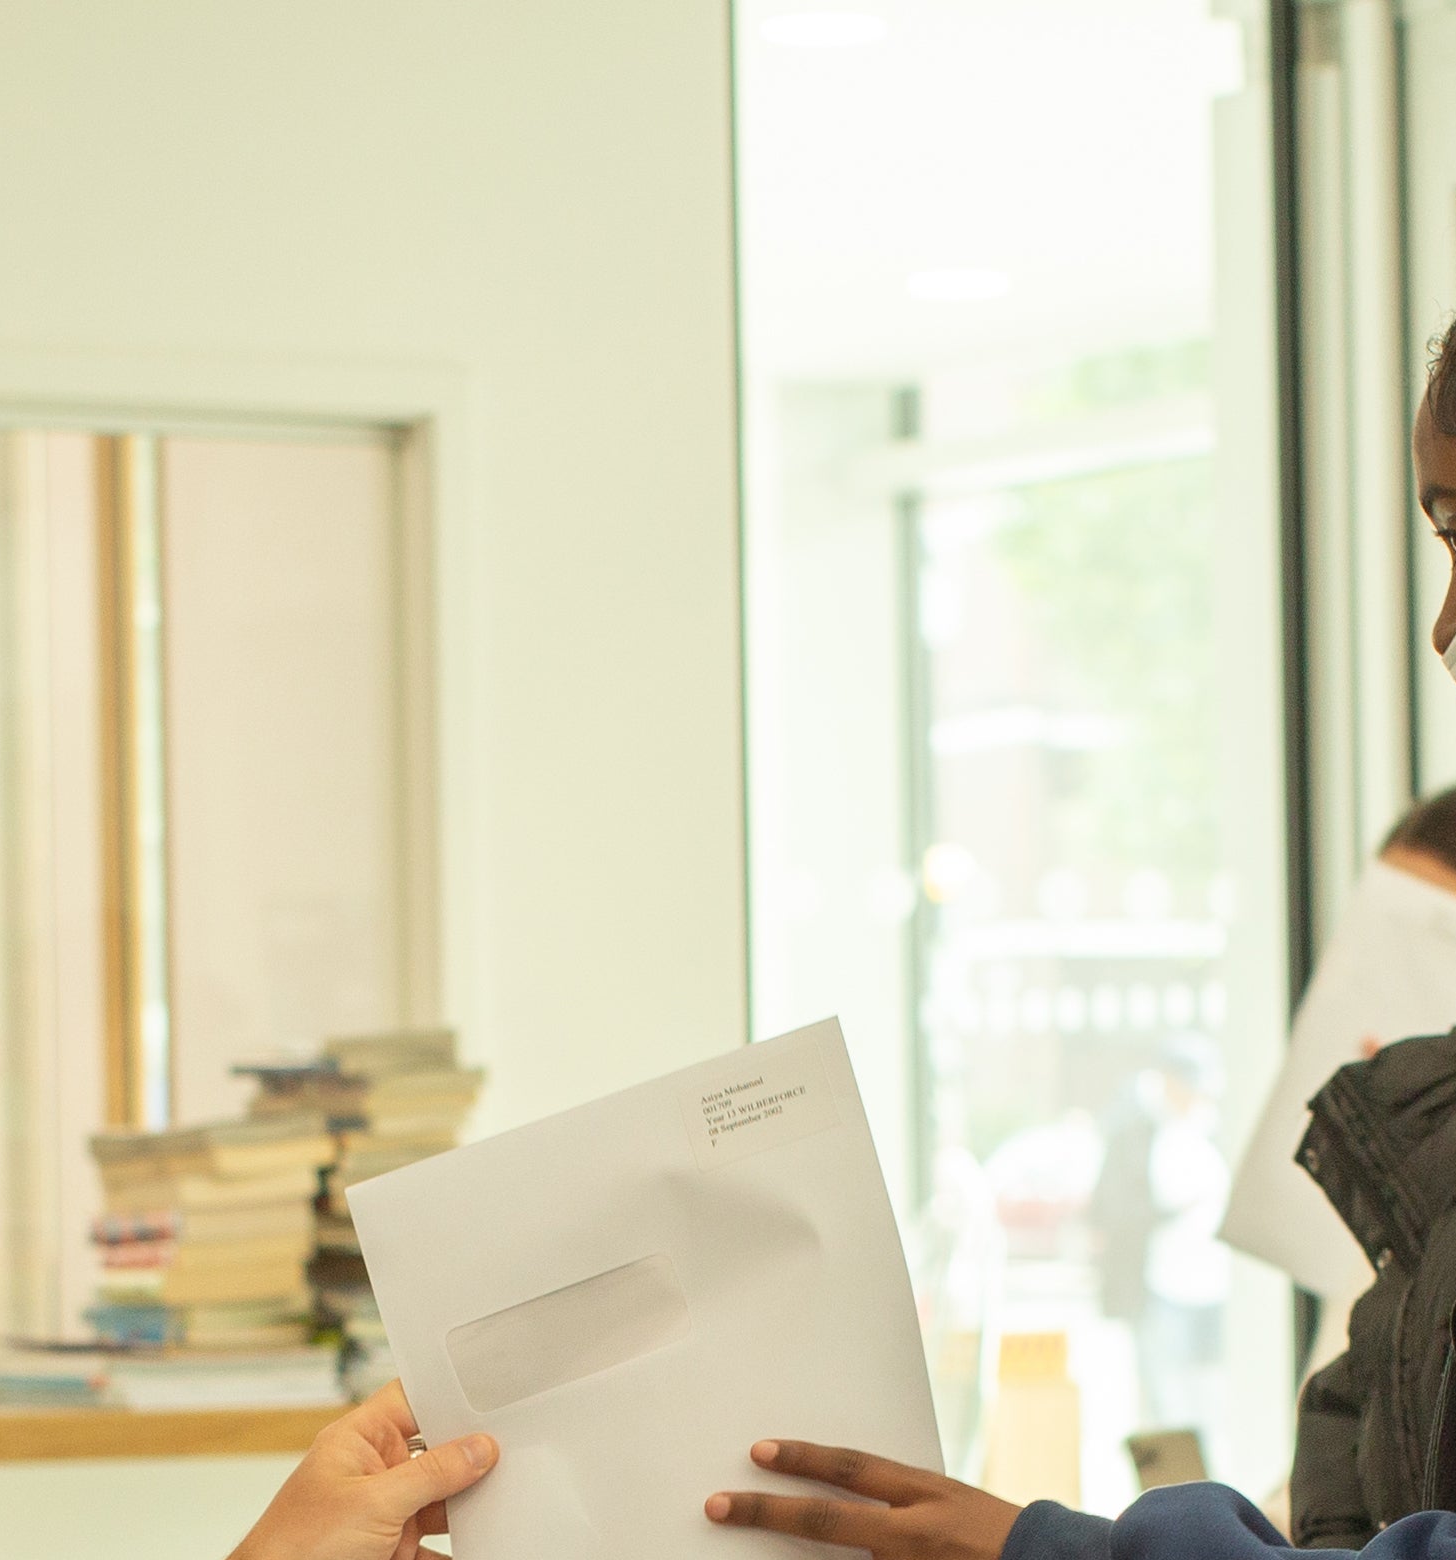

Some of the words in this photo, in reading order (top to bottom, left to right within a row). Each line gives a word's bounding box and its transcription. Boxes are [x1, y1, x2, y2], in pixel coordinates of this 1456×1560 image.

[724, 1076, 764, 1095] Mohamed
[738, 1086, 805, 1114] WILBERFORCE
[721, 1114, 761, 1133] September
